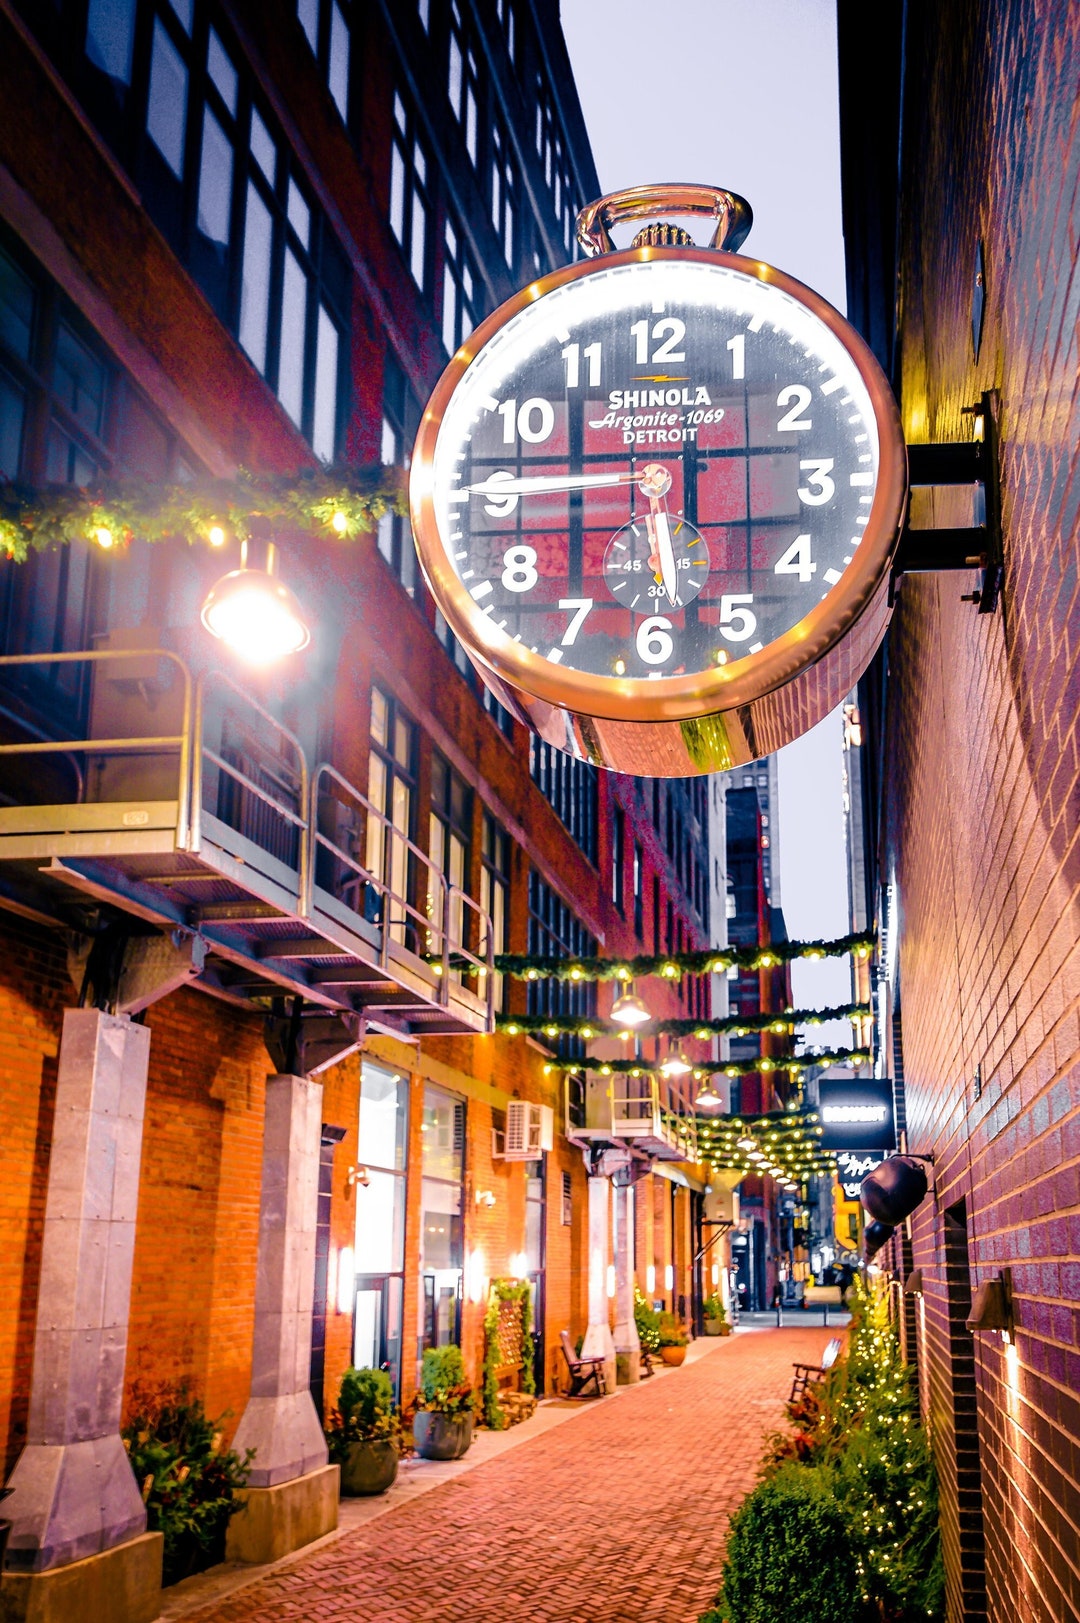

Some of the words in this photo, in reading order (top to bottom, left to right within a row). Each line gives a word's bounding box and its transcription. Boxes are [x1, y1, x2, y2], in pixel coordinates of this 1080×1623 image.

[562, 342, 602, 388] 11
[630, 318, 686, 365] 12
[726, 334, 746, 380] 1
[498, 397, 555, 444] 10
[588, 408, 725, 431] Argonite-1069
[608, 385, 712, 410] SHINOLA
[775, 384, 813, 432] 2
[623, 427, 699, 445] DETROIT
[797, 457, 836, 506] 3
[501, 545, 538, 593] 8
[623, 559, 642, 572] 45
[676, 557, 691, 570] 15
[774, 534, 817, 583] 4
[647, 585, 667, 598] 30
[558, 598, 594, 646] 7
[635, 616, 674, 665] 6
[718, 593, 758, 642] 5
